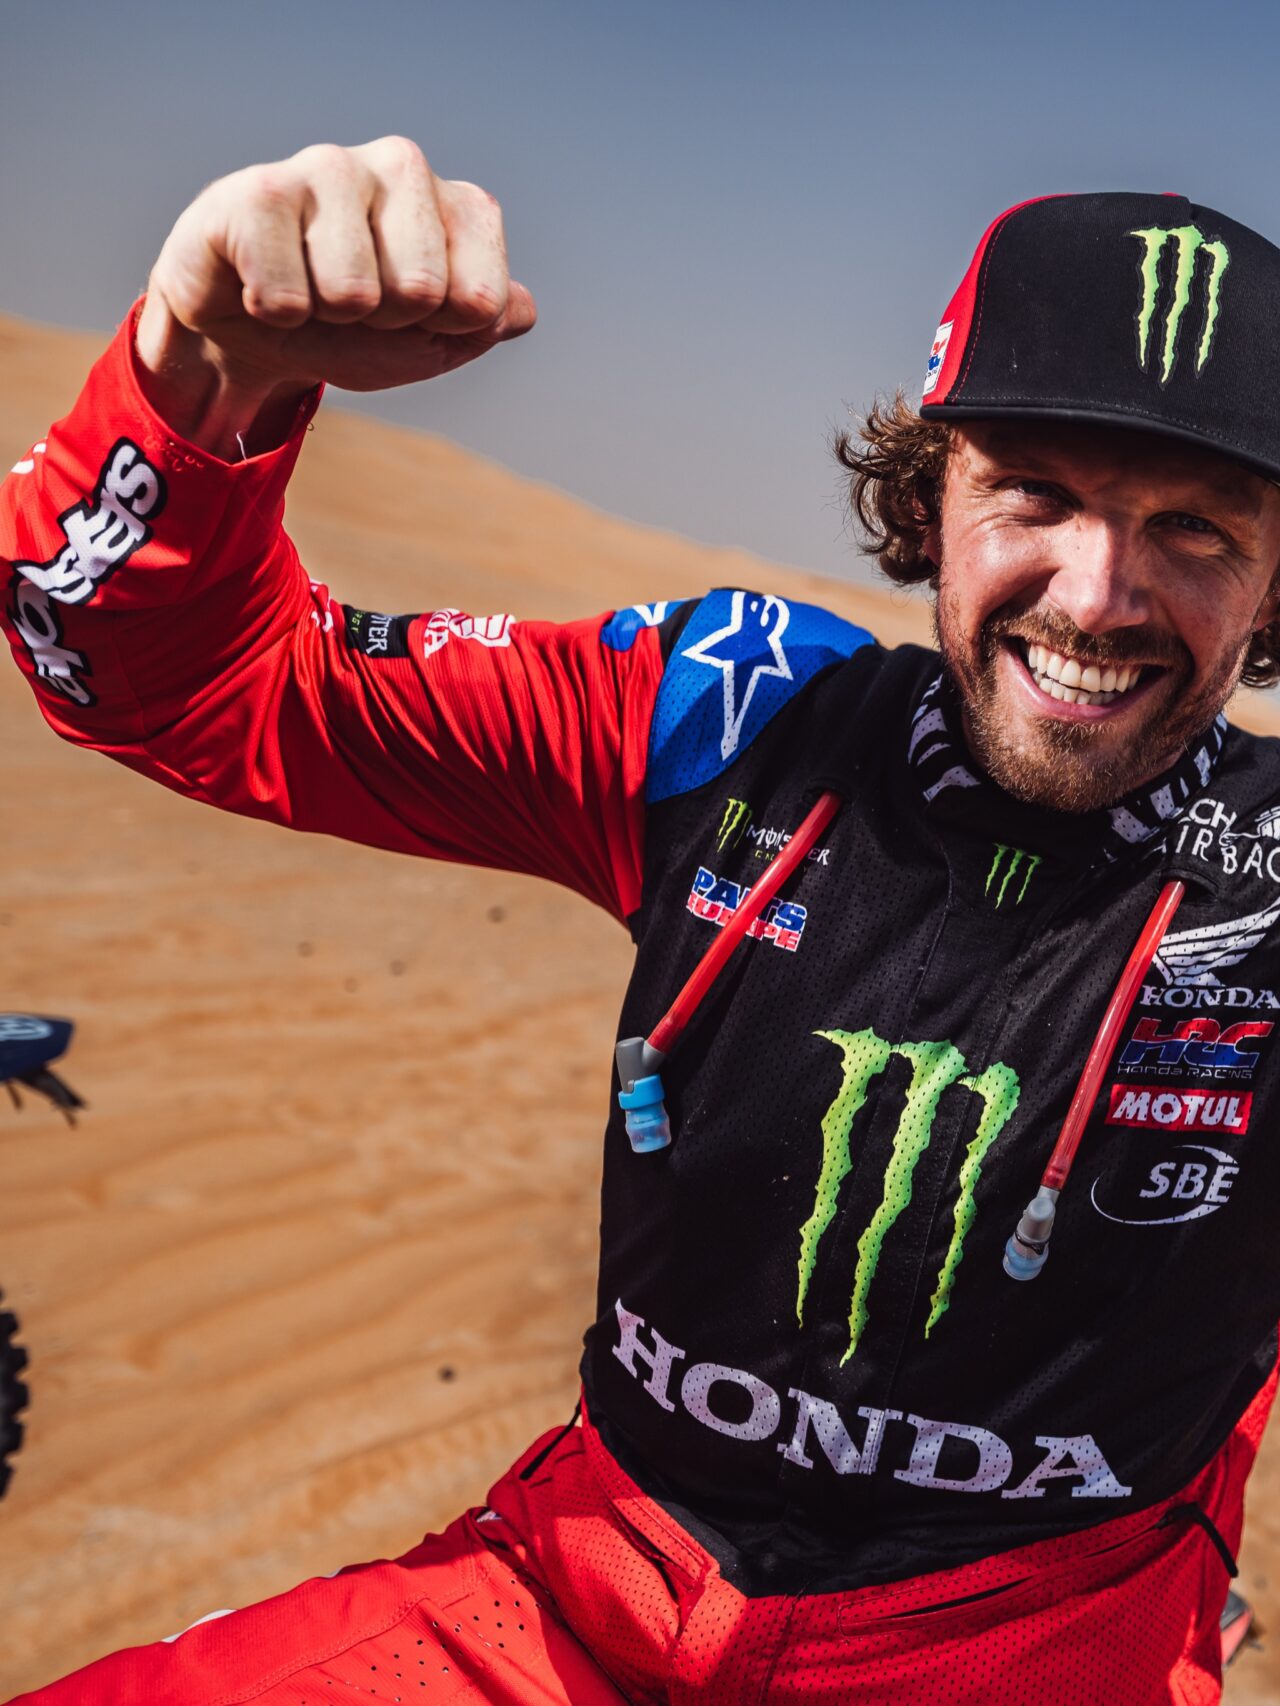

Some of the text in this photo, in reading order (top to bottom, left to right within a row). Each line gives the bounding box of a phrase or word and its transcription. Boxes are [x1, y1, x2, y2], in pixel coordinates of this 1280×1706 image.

[745, 823, 831, 867] MONSER
[691, 865, 808, 933] PATS
[1118, 1016, 1276, 1069] HRC
[1112, 1090, 1244, 1128] MOTUL
[1138, 1161, 1240, 1204] SBE
[611, 1297, 1133, 1499] HONDA
